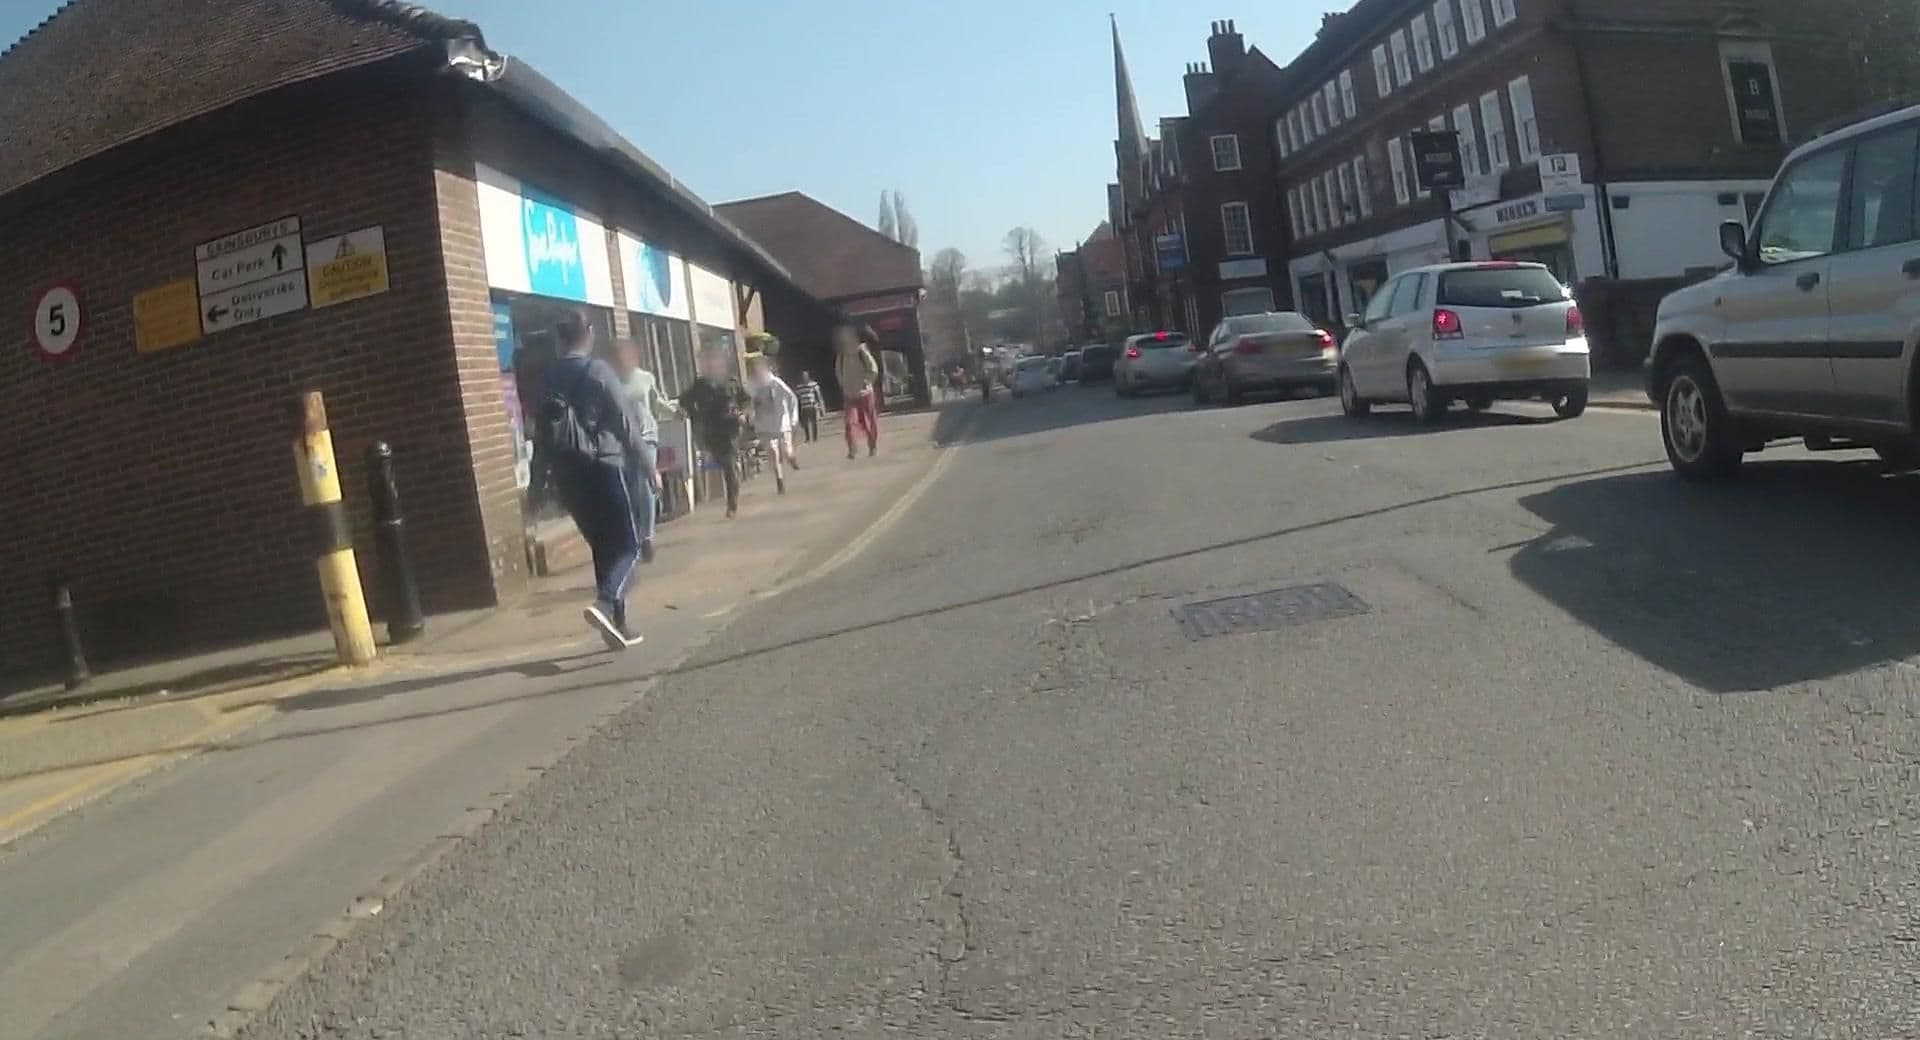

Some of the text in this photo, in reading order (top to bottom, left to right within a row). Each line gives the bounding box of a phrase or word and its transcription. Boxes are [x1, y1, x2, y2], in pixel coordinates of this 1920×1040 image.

[211, 258, 266, 282] Car Park
[231, 281, 296, 306] Deliveries
[48, 304, 67, 337] 5
[234, 306, 263, 322] Only
